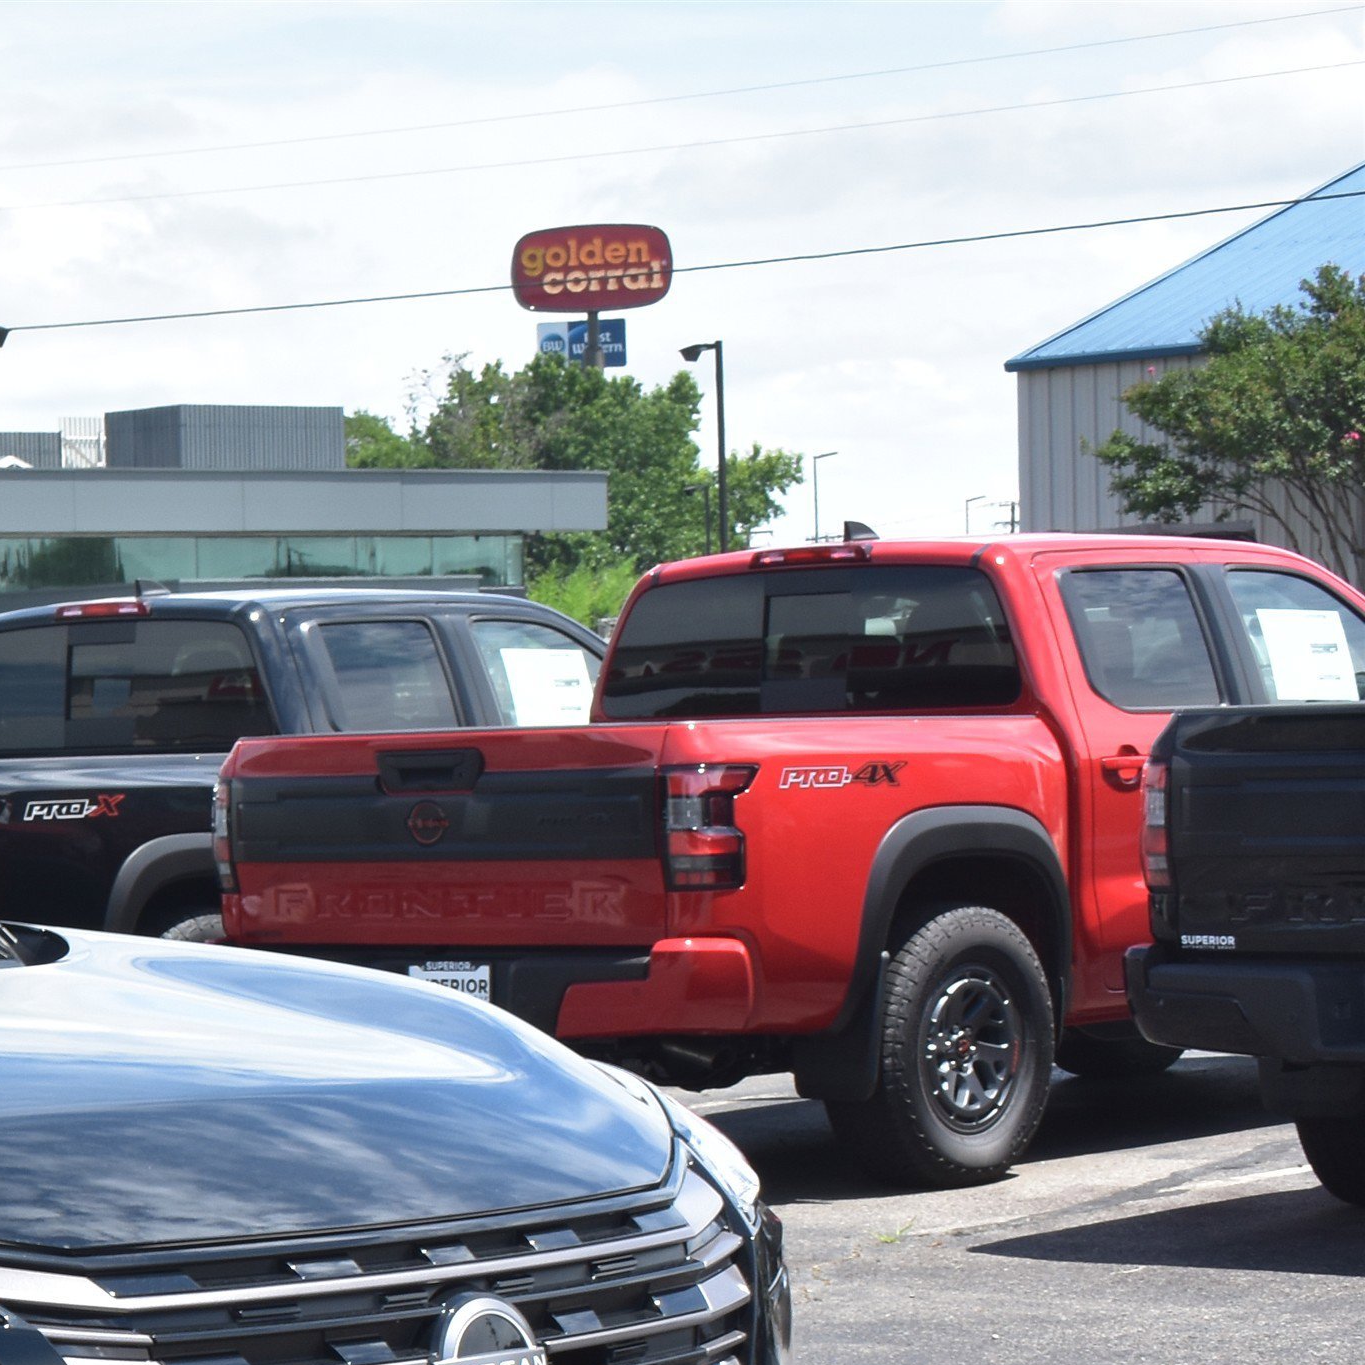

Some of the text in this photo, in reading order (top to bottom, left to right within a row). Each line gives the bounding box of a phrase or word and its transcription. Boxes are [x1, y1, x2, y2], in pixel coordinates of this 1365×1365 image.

[521, 238, 650, 277] golden
[543, 261, 664, 294] corral
[275, 888, 623, 919] FRONTIER
[1180, 934, 1236, 945] SUPERIOR
[425, 961, 471, 971] SUPERIOR
